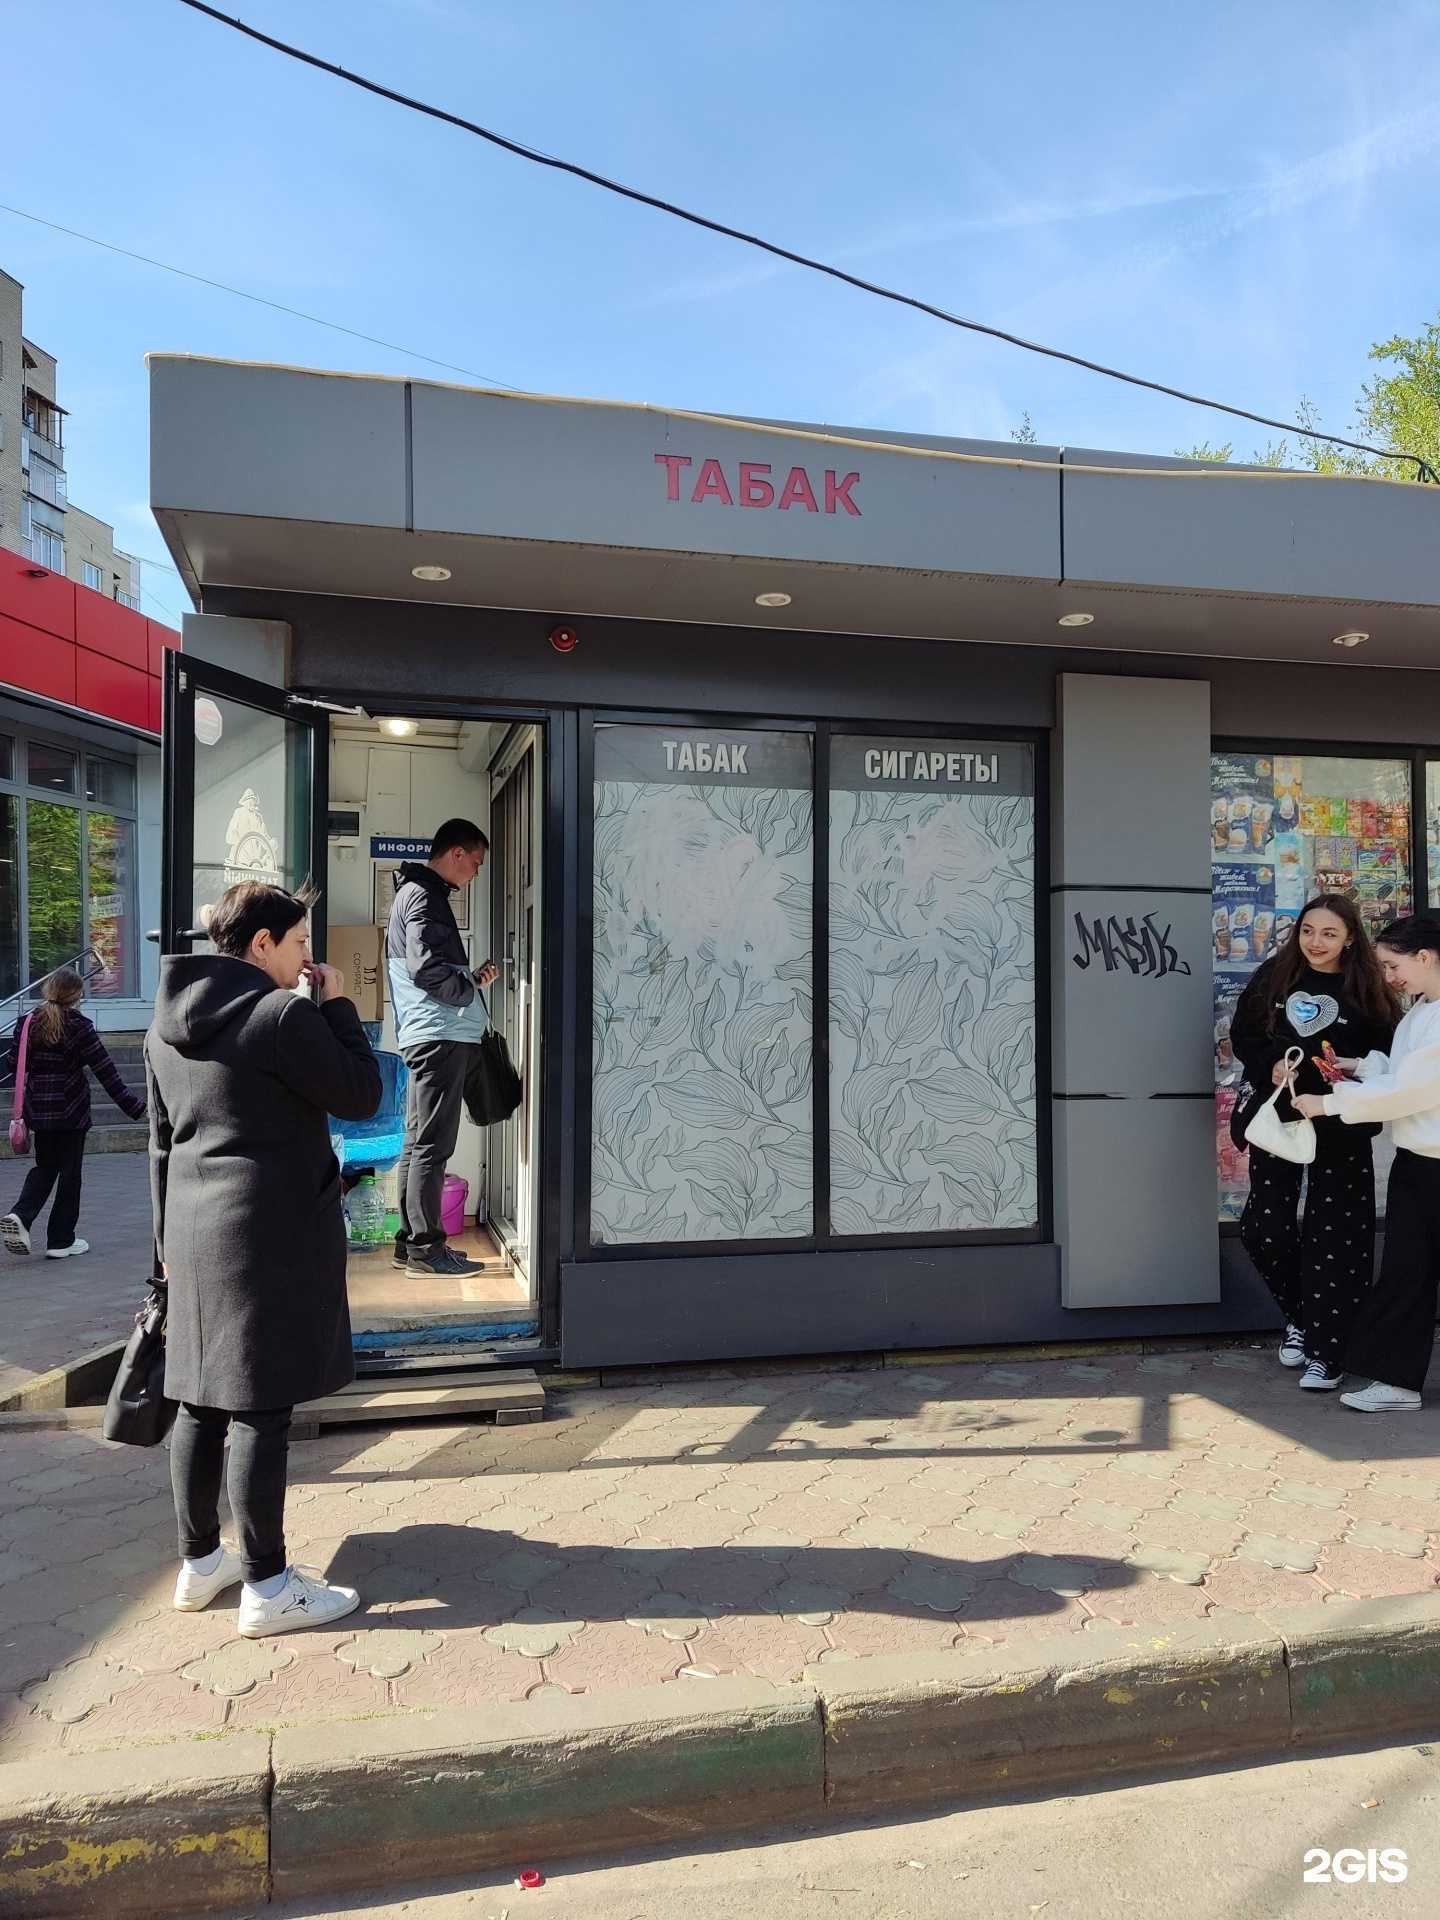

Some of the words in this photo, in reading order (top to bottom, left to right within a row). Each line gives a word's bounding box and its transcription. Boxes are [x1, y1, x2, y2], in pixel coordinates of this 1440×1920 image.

[655, 454, 863, 516] ТАБАК
[662, 741, 748, 774] ТАБАК
[864, 749, 998, 783] СИГАРЕТЫ
[352, 952, 362, 996] COMPACT
